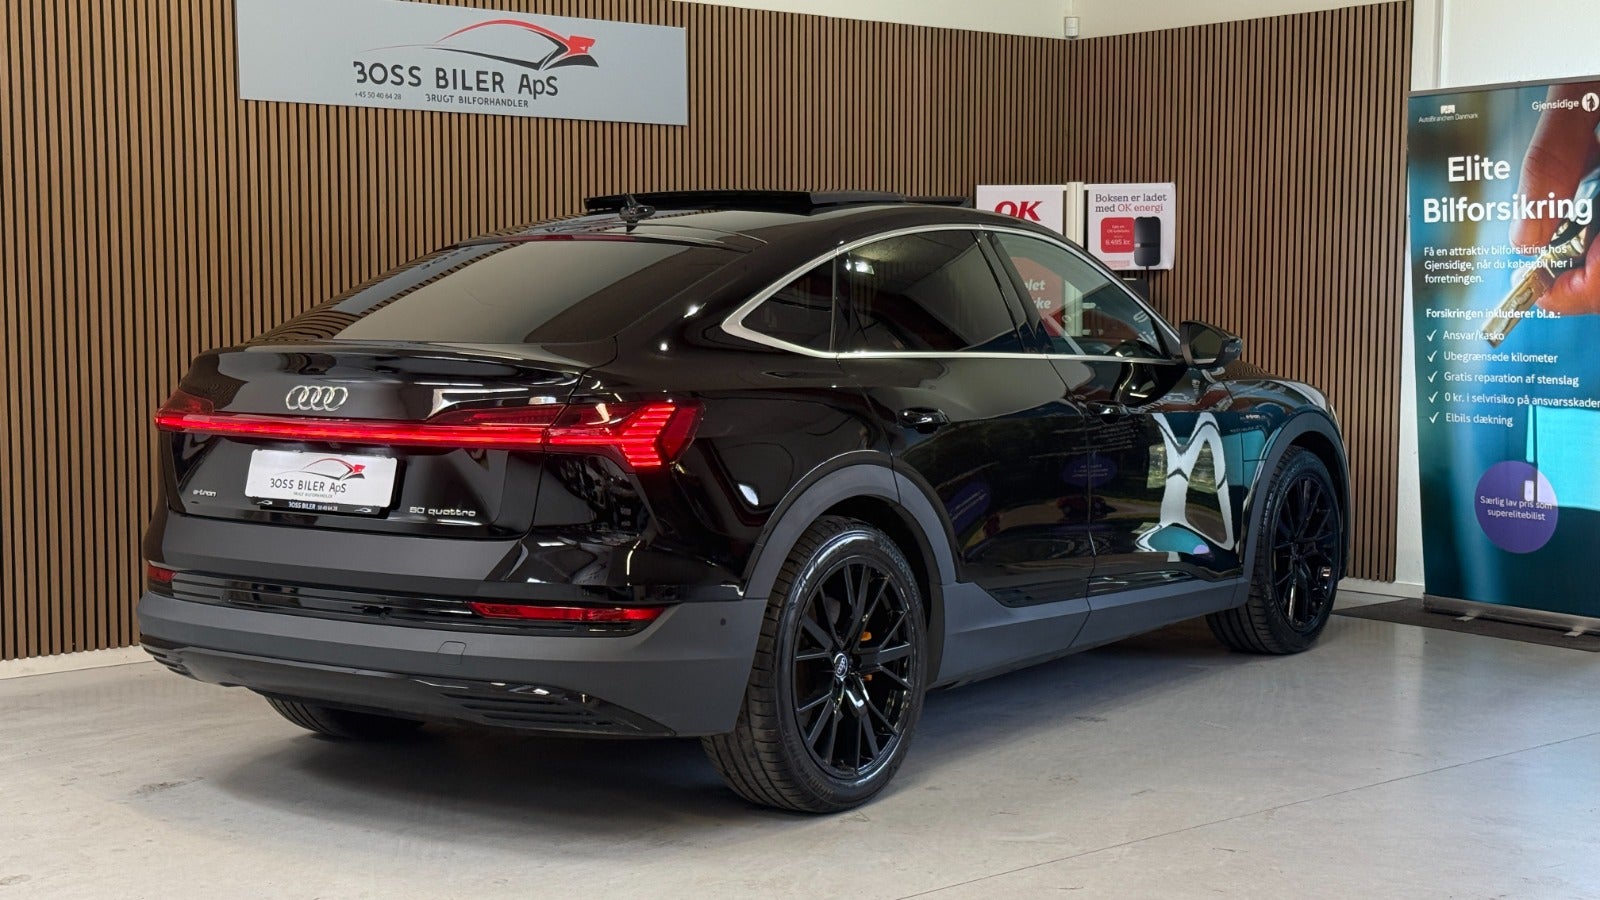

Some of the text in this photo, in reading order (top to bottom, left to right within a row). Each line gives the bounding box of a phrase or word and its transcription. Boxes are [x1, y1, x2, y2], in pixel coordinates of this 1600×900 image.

[436, 67, 505, 93] BILER
[518, 74, 559, 99] ApS
[425, 94, 528, 108] BRUGT BILFORHANDLER
[1532, 100, 1579, 113] Gjensidige
[1448, 155, 1511, 182] Elite
[1096, 194, 1128, 202] Boksen
[1144, 194, 1167, 202] ladet
[995, 200, 1042, 221] OK
[1096, 204, 1115, 212] med
[1134, 204, 1163, 213] energi
[1423, 192, 1592, 225] Bilforsikring
[1424, 244, 1567, 257] Få en attraktiv bilforsikring hos
[1424, 260, 1474, 272] Gjensidige,
[1476, 258, 1491, 269] når
[1493, 260, 1506, 269] du
[1551, 258, 1567, 268] her
[1570, 258, 1573, 268] i
[1425, 274, 1484, 286] forretningen.
[1426, 308, 1561, 320] Forsikringen inkluderer bl.a.:
[1443, 330, 1504, 341] Ansvar/kasko
[1443, 352, 1558, 363] Ubegrænsede kilometer
[1444, 372, 1579, 387] Gratis reparation af stenslag
[1445, 392, 1600, 408] 0 kr. i selvrisiko på ansvarsskader
[1446, 413, 1513, 426] Elbils dækning
[298, 480, 324, 492] BILER
[329, 482, 346, 495] ApS
[1480, 496, 1504, 507] Særlig
[1506, 497, 1517, 507] lav
[1519, 499, 1534, 509] pris
[428, 508, 476, 517] quattro
[1487, 509, 1545, 521] superelitebilist
